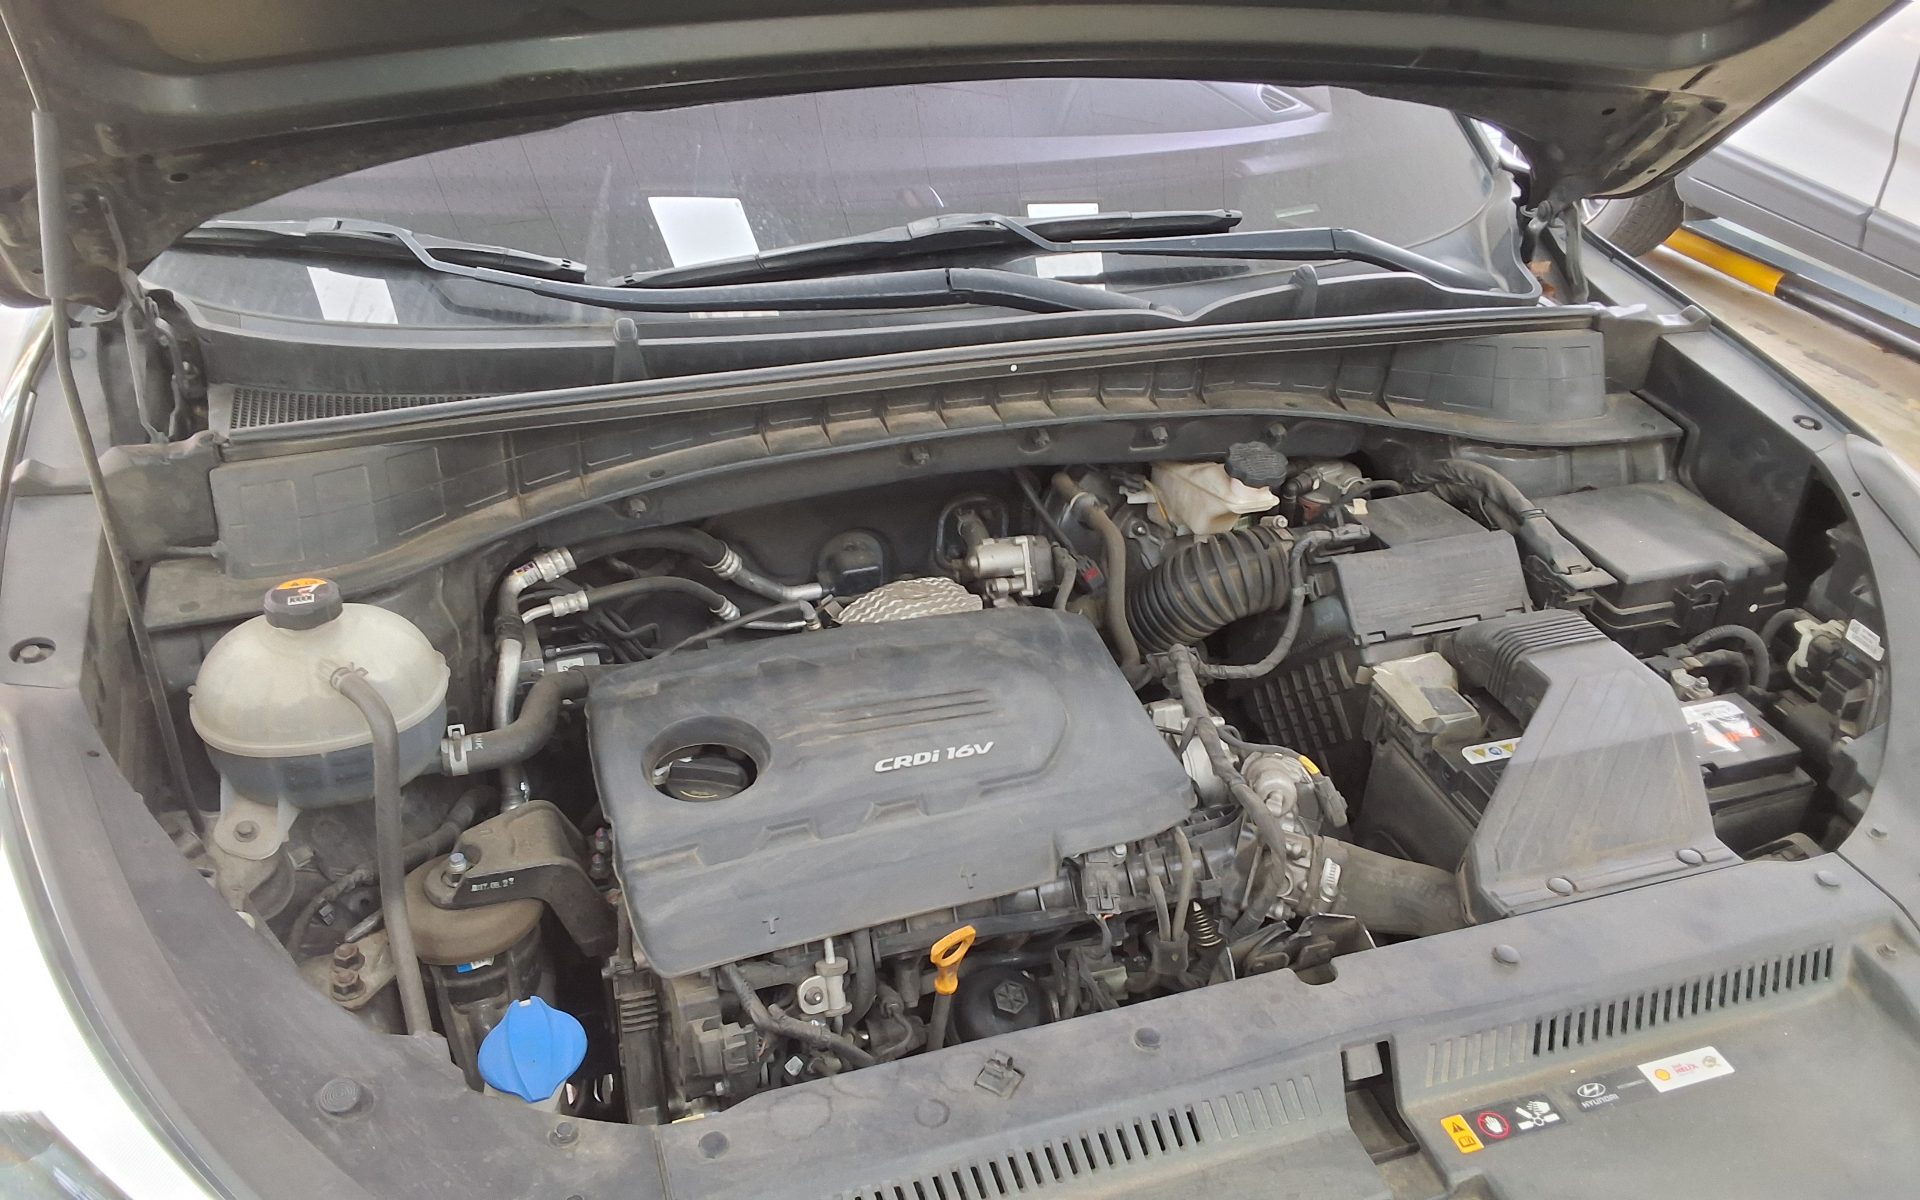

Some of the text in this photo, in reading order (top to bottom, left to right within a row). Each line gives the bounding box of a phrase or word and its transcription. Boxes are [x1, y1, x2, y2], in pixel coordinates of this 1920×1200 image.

[874, 741, 994, 772] CRDi 16V
[1581, 1093, 1620, 1109] HYUNDAI
